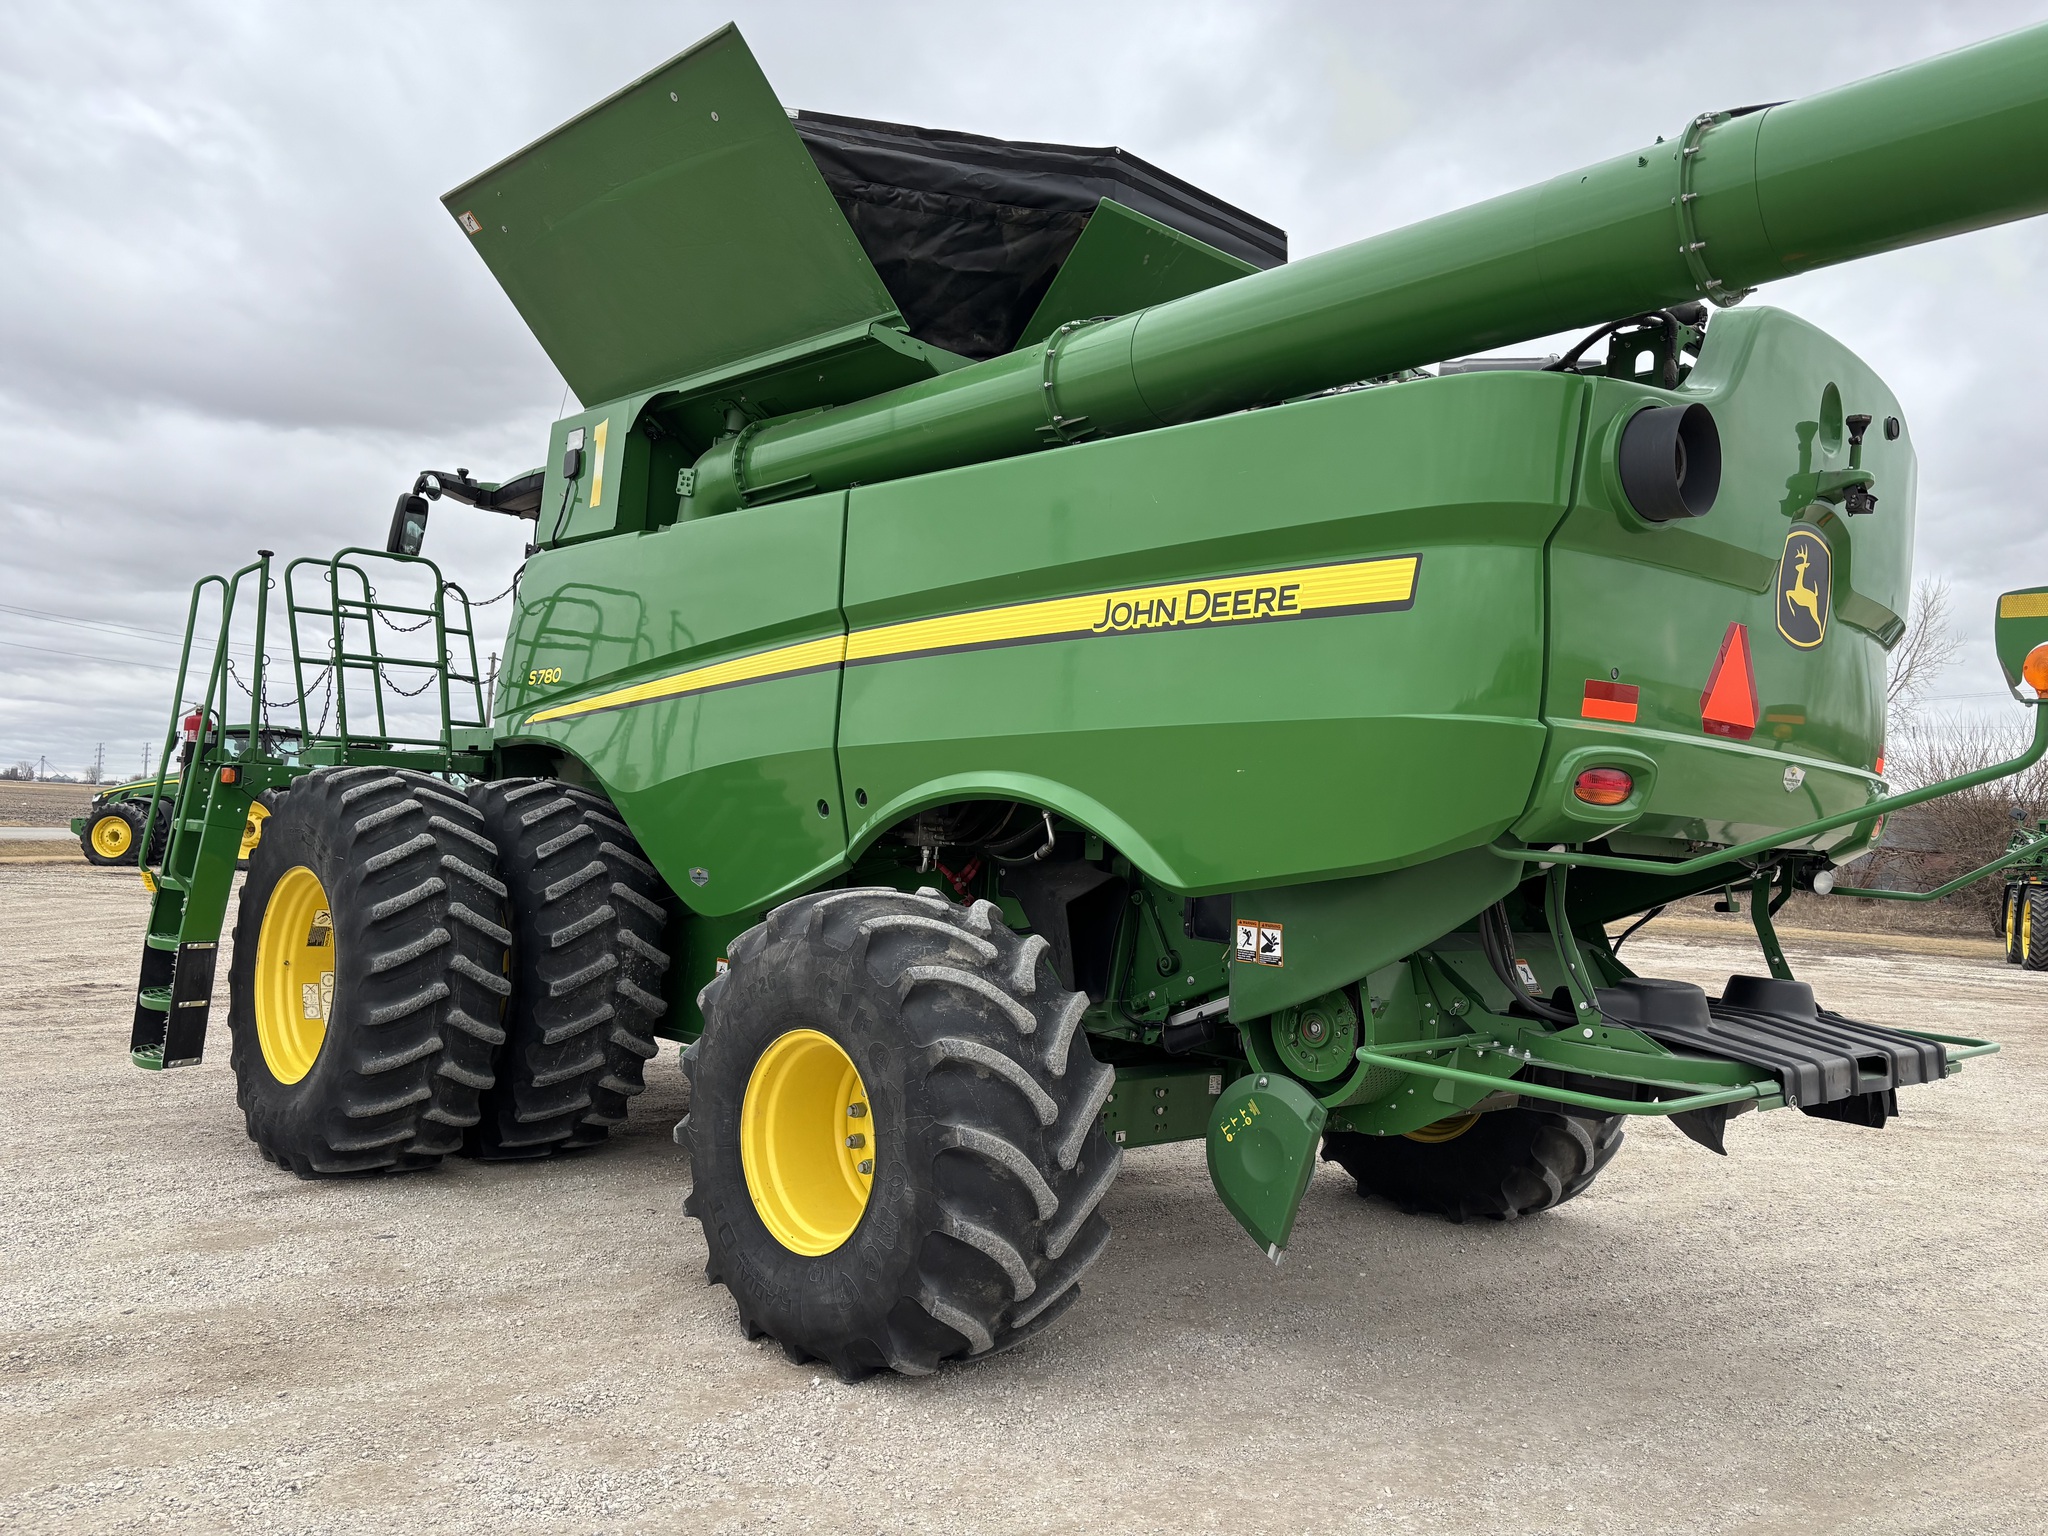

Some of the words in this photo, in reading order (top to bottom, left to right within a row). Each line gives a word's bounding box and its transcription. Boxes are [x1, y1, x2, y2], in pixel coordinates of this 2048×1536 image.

[589, 417, 609, 508] 1
[1092, 597, 1177, 630] JOHN
[1184, 583, 1301, 621] DEERE
[528, 667, 562, 685] S780
